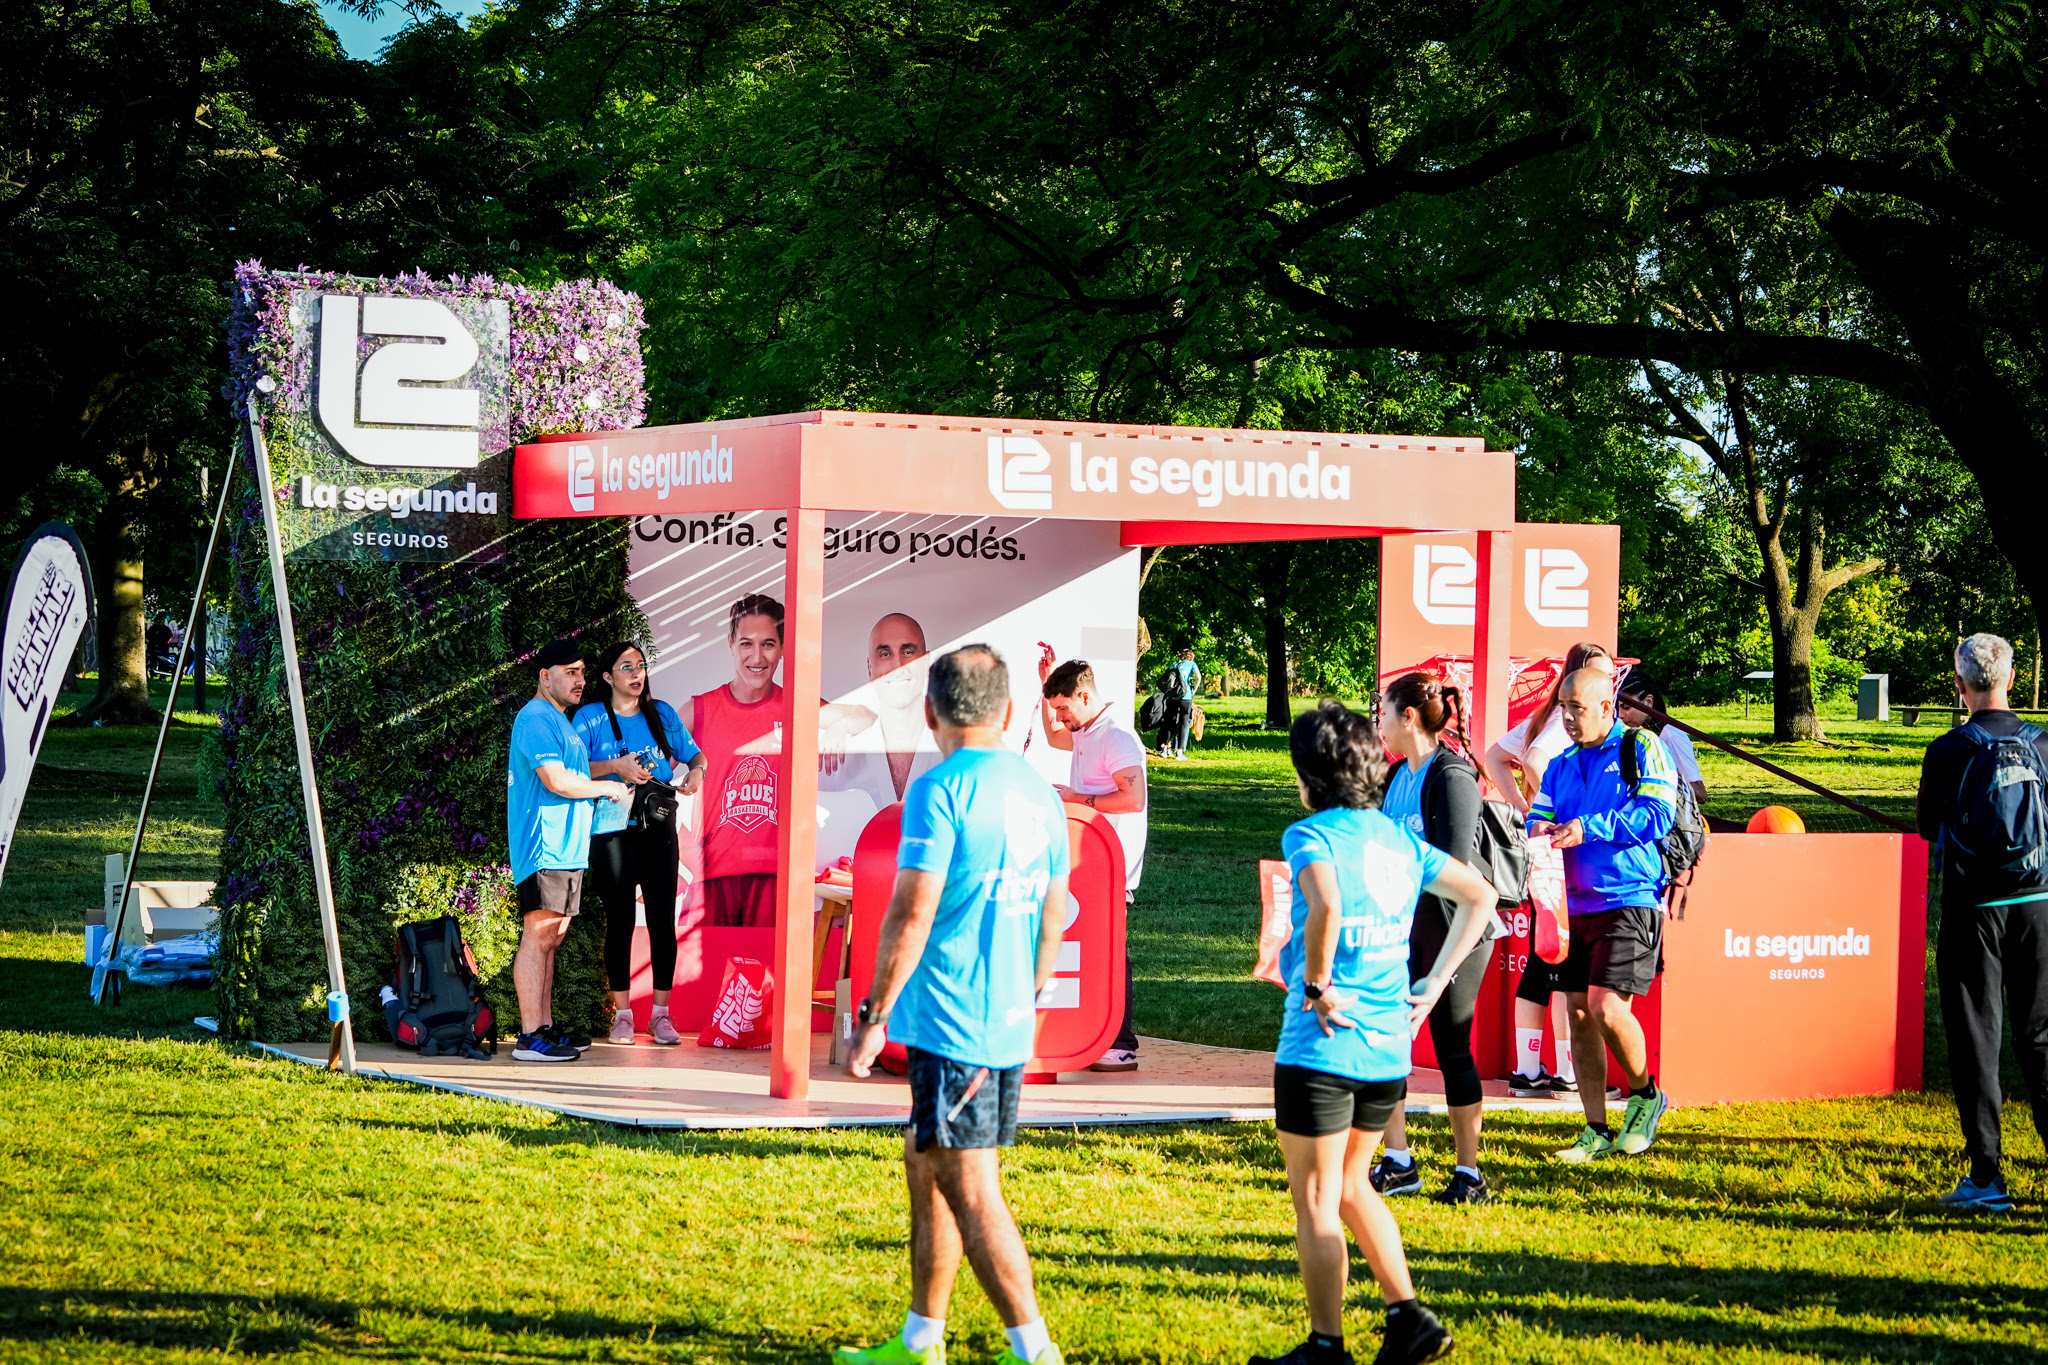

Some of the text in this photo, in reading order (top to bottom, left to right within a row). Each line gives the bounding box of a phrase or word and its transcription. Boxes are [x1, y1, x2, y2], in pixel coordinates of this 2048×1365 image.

[602, 446, 623, 493] la
[627, 434, 733, 500] segunda
[1070, 442, 1118, 492] la
[1129, 450, 1351, 508] segunda
[301, 475, 498, 519] la segunda
[352, 531, 449, 549] SEGUROS
[635, 511, 1026, 563] Confía. Sguro podés.
[8, 582, 51, 692] HABLAR
[16, 568, 75, 709] GANAR
[729, 805, 766, 816] BASKETBALL
[1725, 927, 1870, 963] la segunda
[1769, 968, 1825, 980] SEGUROS
